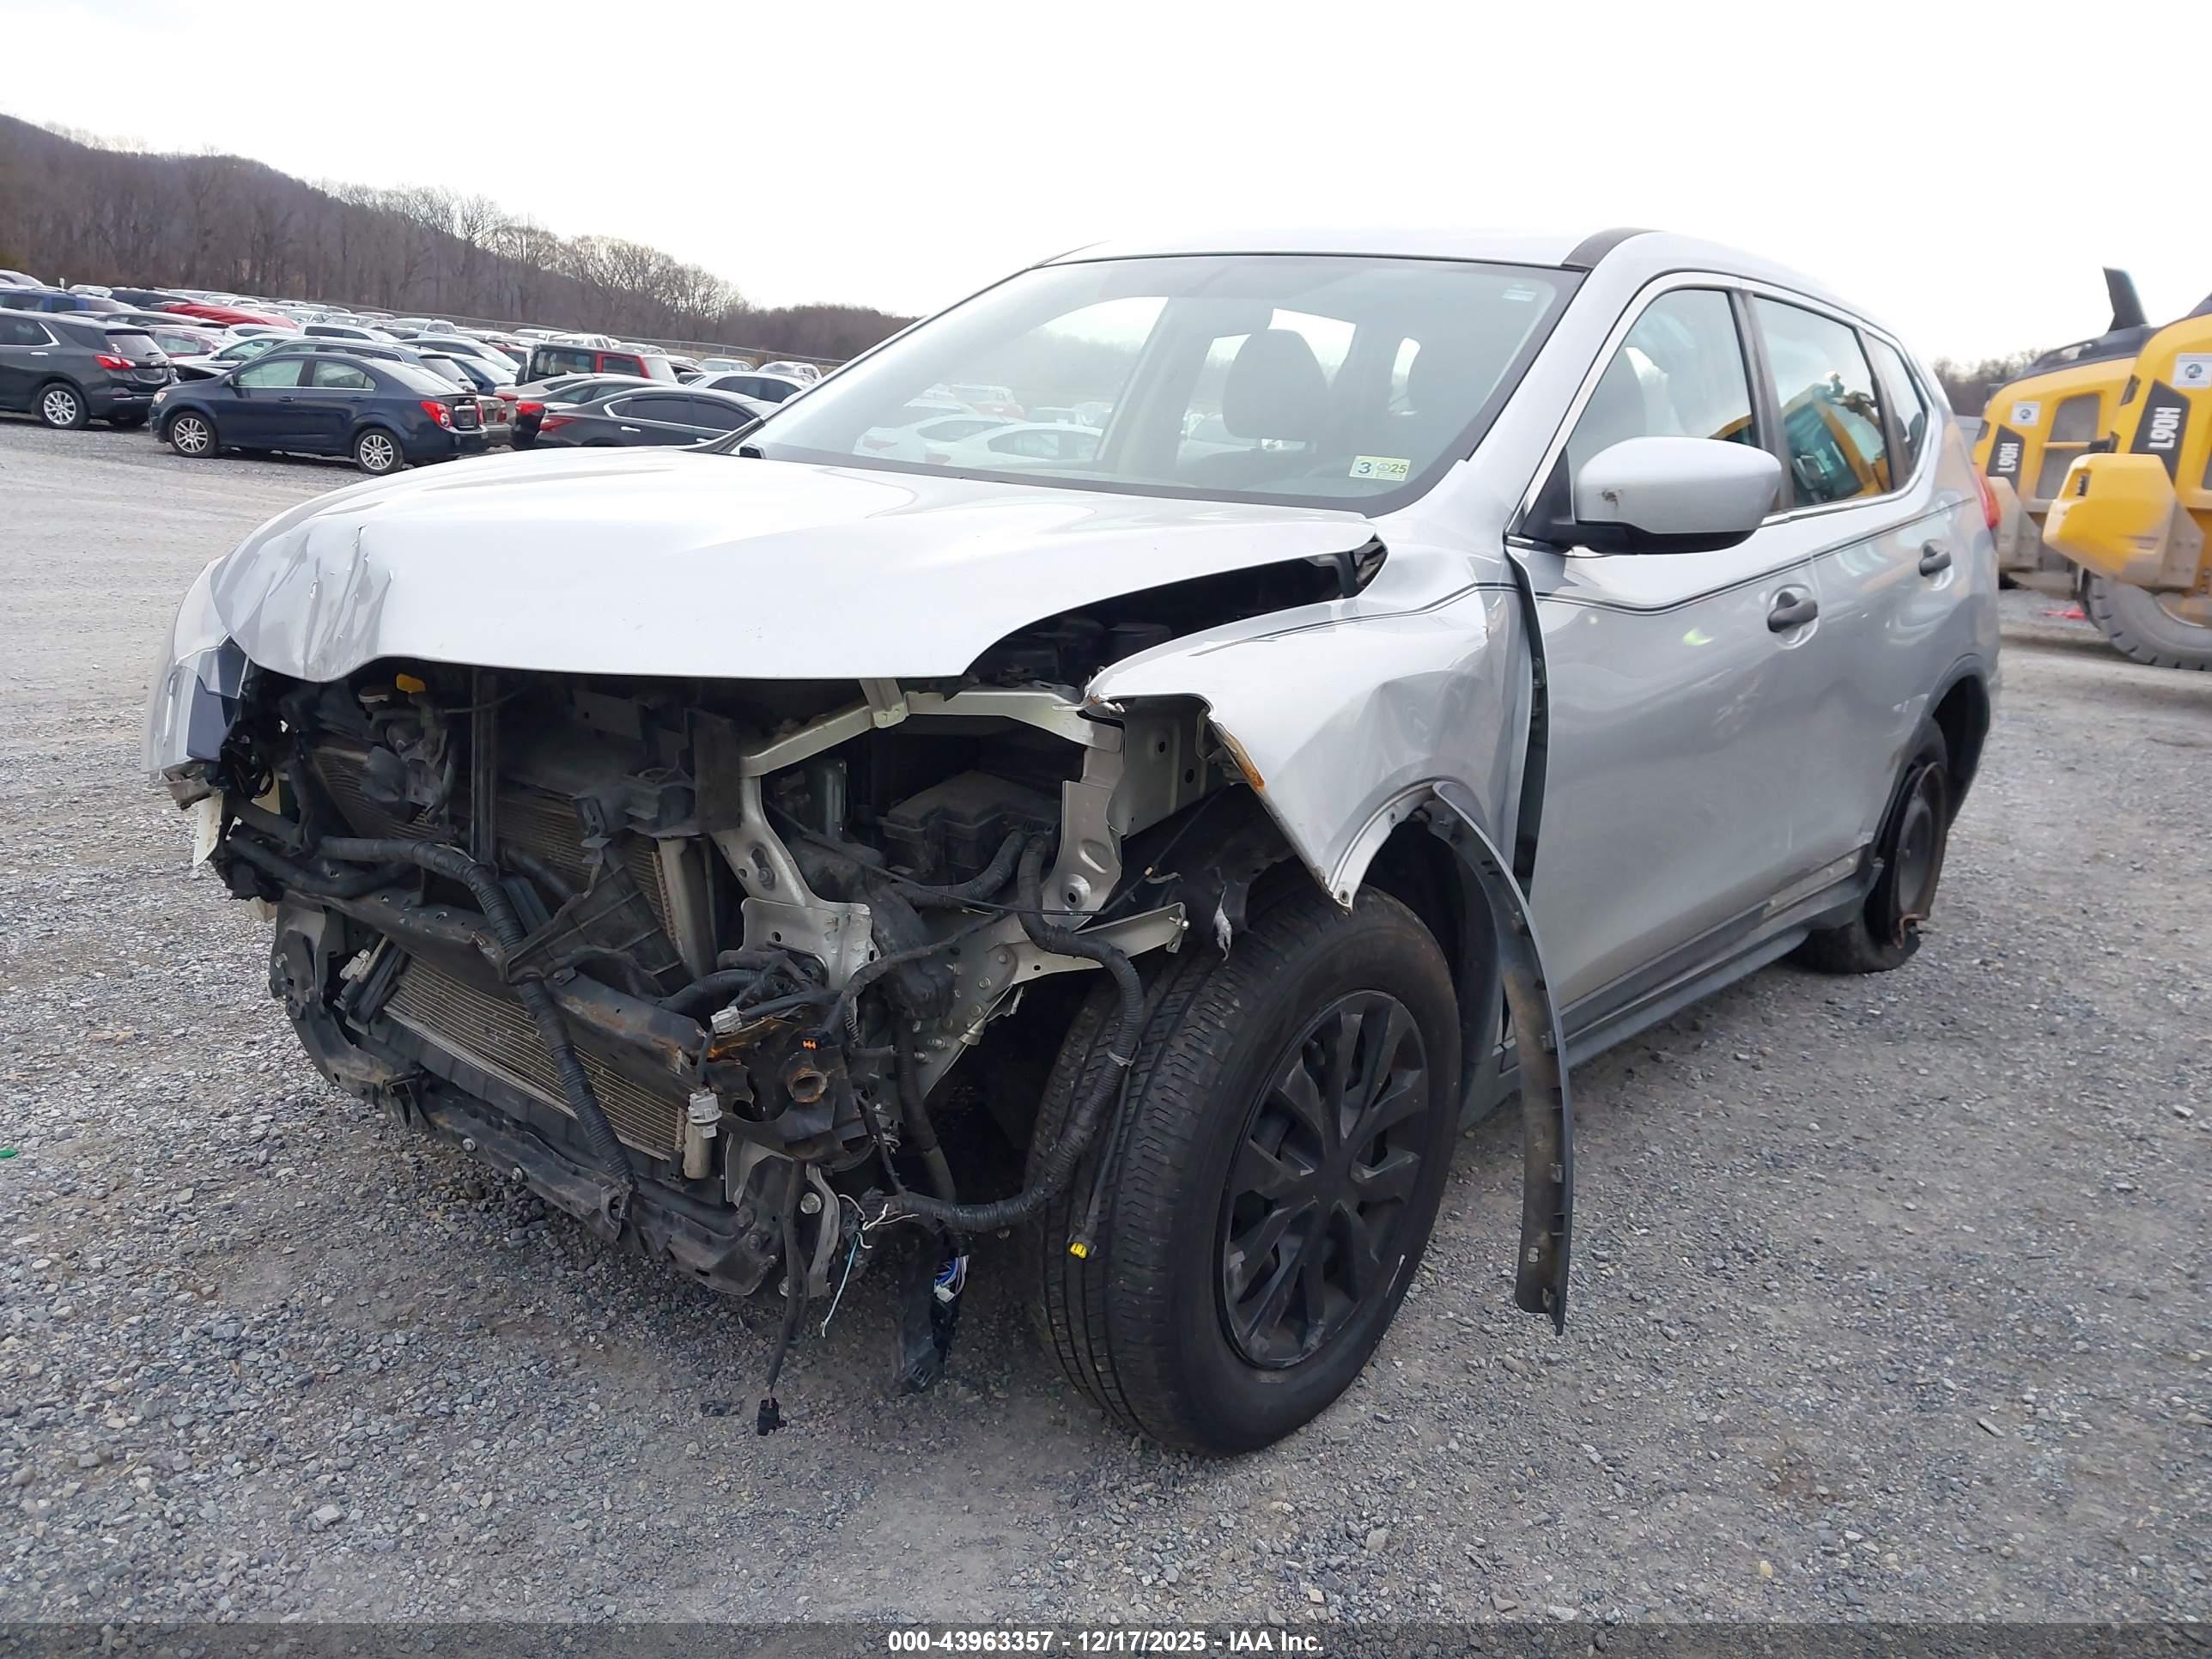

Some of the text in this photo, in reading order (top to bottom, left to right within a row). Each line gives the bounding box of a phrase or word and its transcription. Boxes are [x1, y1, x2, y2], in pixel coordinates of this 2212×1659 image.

[2148, 406, 2182, 449] L90H
[1358, 462, 1408, 474] 3 25
[1996, 442, 2020, 472] L90H
